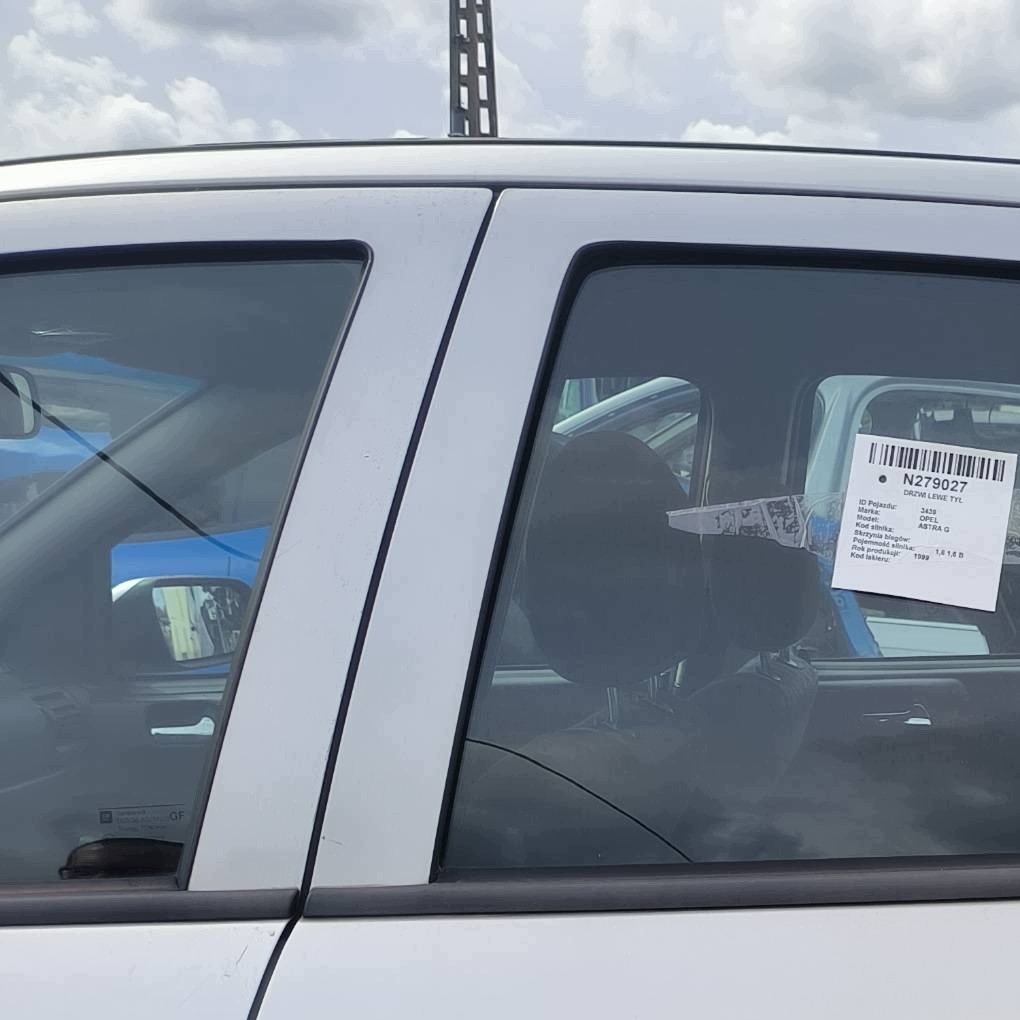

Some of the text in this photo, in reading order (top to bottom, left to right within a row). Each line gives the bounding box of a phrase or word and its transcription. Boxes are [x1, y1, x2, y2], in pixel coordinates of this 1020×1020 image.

[903, 473, 968, 493] N279027
[904, 490, 964, 504] DRZWI LEWE TYŁ
[868, 500, 898, 510] Pojazdu:
[858, 506, 939, 524] Marka: OPEL
[855, 521, 895, 532] Kod silnika:
[857, 514, 879, 523] Model:
[918, 522, 942, 532] ASTRA
[853, 536, 890, 547] Pojemność
[854, 529, 911, 543] Skrzynia biegów:
[851, 544, 929, 561] Rok produkcji: 1999
[865, 554, 890, 562] lakieru:
